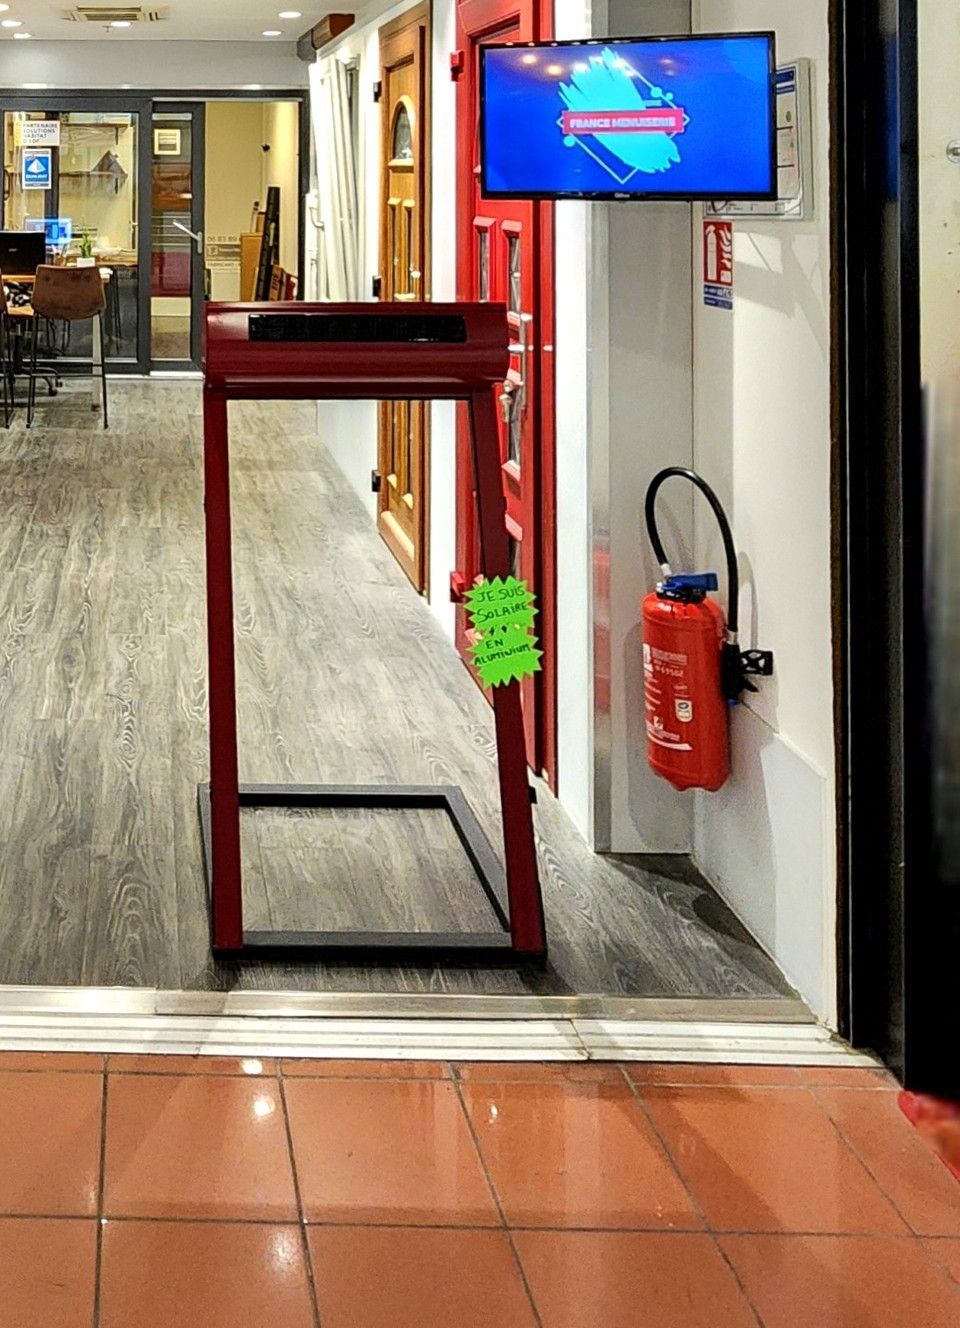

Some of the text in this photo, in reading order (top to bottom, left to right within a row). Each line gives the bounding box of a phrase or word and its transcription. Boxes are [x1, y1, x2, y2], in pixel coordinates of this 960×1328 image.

[569, 118, 610, 128] FRANCE
[478, 586, 526, 603] JE SUIS
[476, 602, 528, 623] SOLAIRE
[486, 639, 503, 649] EN
